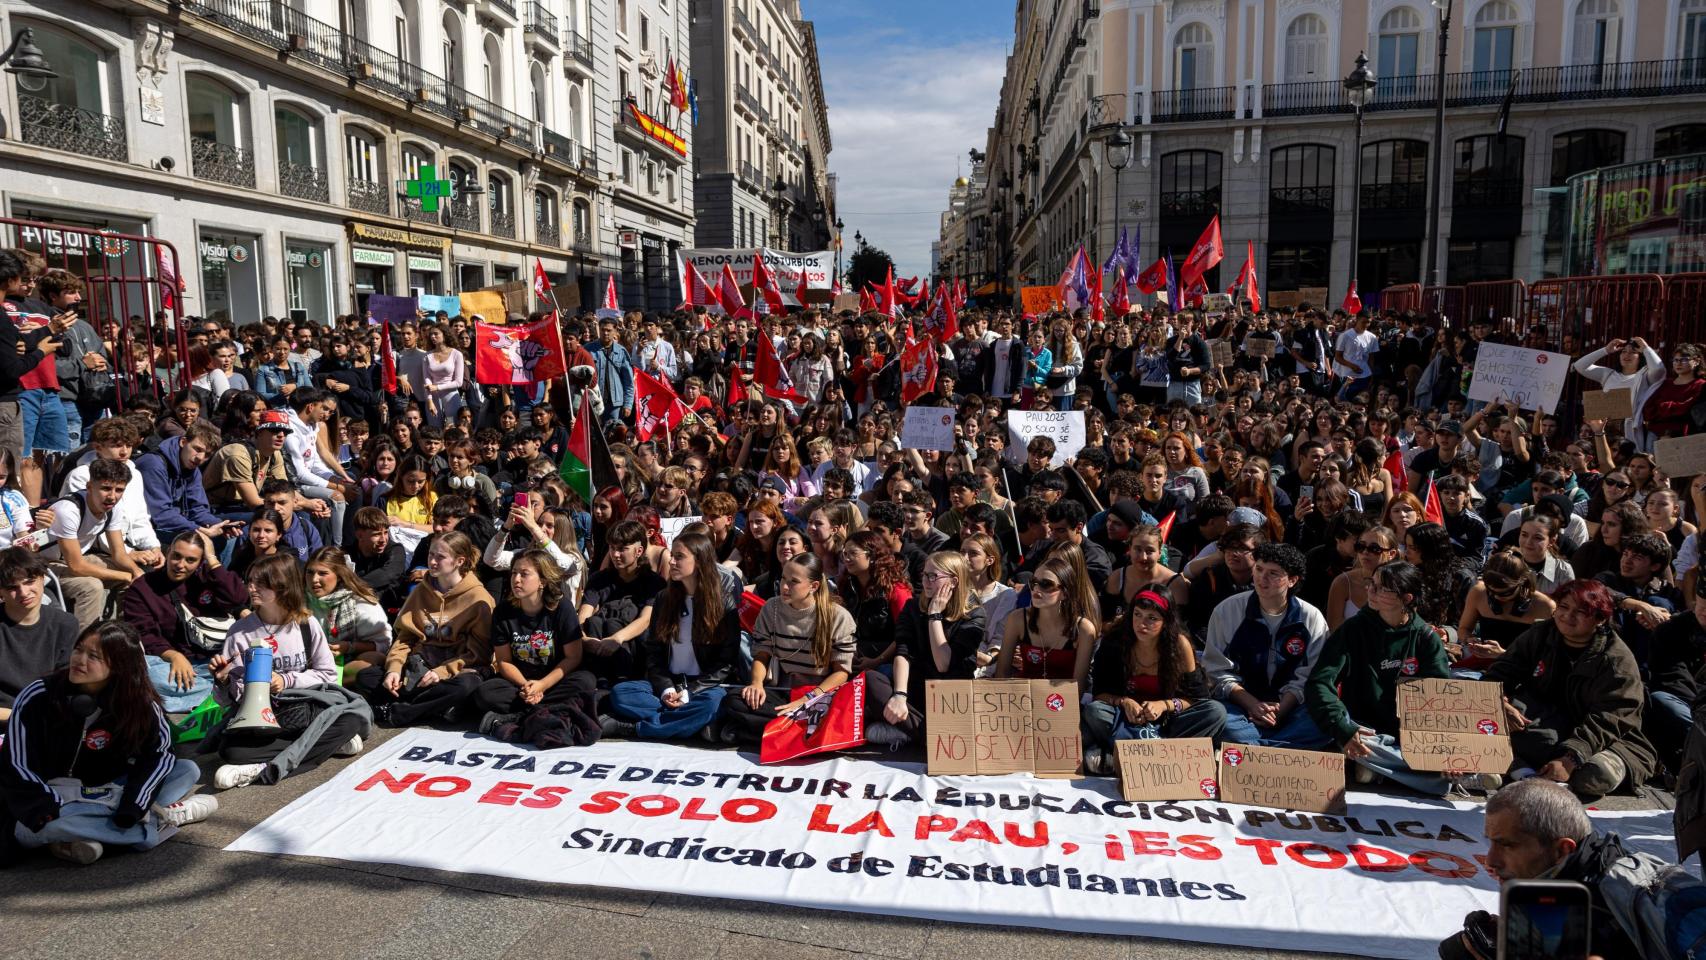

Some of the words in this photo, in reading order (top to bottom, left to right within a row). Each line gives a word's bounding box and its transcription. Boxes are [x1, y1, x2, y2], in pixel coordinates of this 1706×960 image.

[419, 182, 441, 195] 12H
[1604, 191, 1627, 210] BIG
[365, 226, 404, 240] FARMACIA
[354, 250, 392, 263] FARMACIA
[409, 257, 441, 269] COMPANY
[1512, 350, 1528, 361] ME
[1474, 373, 1516, 387] DANIEL
[1500, 388, 1531, 406] NO!
[1025, 412, 1043, 421] PAU
[1045, 413, 1067, 421] 2025
[1021, 424, 1031, 433] YO
[1036, 425, 1055, 433] SOLO
[1435, 681, 1463, 695] LAS
[930, 683, 1034, 715] ¡NUESTRO
[1405, 696, 1498, 713] EXCUSAS
[979, 715, 1052, 734] FUTURO
[1405, 712, 1468, 729] FUERAN
[1409, 732, 1459, 744] NOTAS
[935, 733, 967, 760] NO
[974, 734, 1000, 760] SE
[1006, 733, 1081, 765] VENDE!
[1122, 743, 1154, 756] EXAMEN
[1186, 745, 1193, 759] 5
[1243, 746, 1311, 768] ANSIEDAD
[1483, 747, 1507, 758] UN
[1123, 761, 1139, 789] EL
[1140, 762, 1183, 787] MODELO
[1235, 769, 1318, 791] CONOCIMIENTO
[397, 746, 536, 772] BASTA
[548, 760, 616, 780] DE
[618, 766, 852, 799] DESTRUIR
[862, 784, 924, 803] LA
[1243, 808, 1478, 843] PÚBLICA
[1243, 788, 1260, 803] DE
[1264, 790, 1280, 804] LA
[354, 768, 472, 798] NO
[477, 781, 572, 809] ES
[579, 790, 778, 823] SOLO
[807, 804, 895, 837] LA
[914, 814, 1080, 855] PAU,
[1105, 829, 1223, 861] ¡ES
[561, 827, 817, 870] Sindicato
[827, 851, 895, 877] de
[906, 855, 1247, 901] Estudiantes
